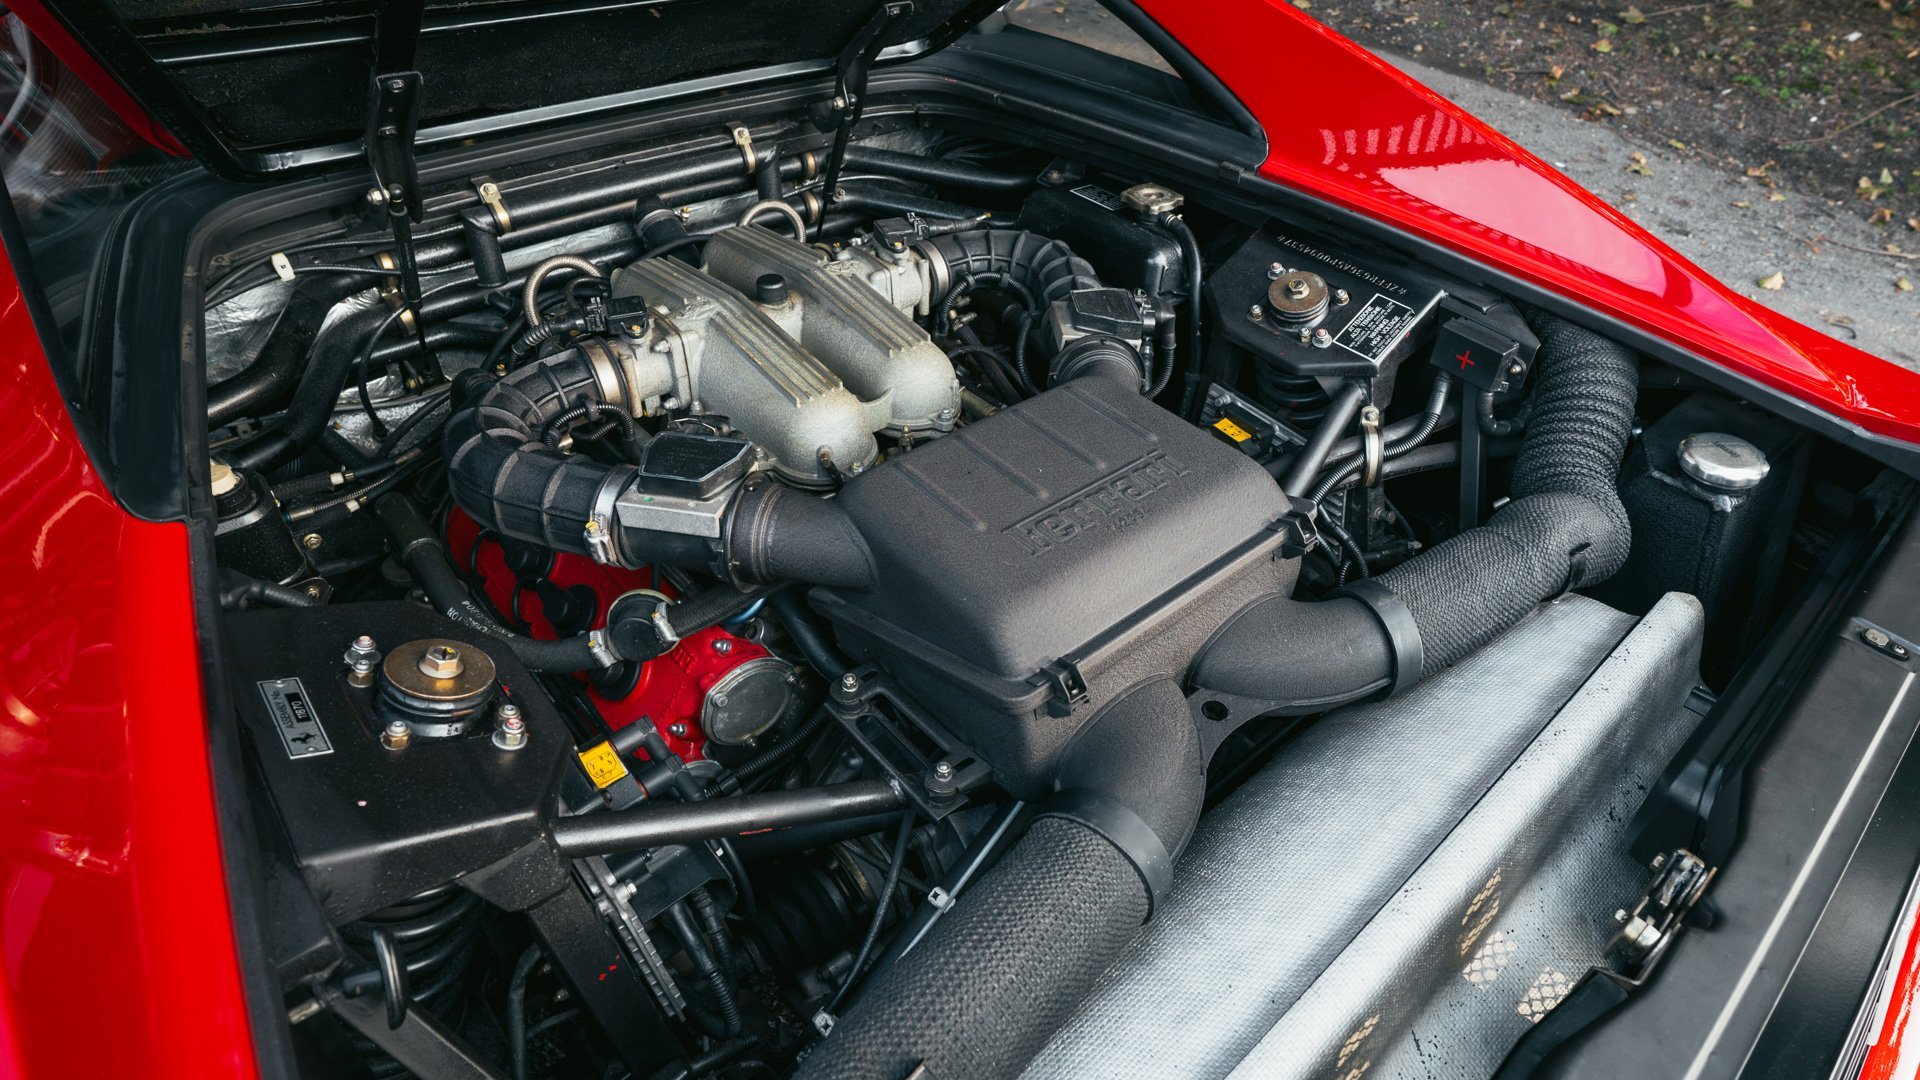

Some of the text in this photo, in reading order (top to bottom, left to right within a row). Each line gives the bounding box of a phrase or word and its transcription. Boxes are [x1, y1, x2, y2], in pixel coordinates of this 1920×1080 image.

[1346, 305, 1374, 332] ATTENZIONE
[1349, 326, 1362, 338] ALTA
[1359, 305, 1382, 327] TENSIONE
[1368, 333, 1383, 347] HIGH
[1379, 314, 1401, 335] VOLTAGE
